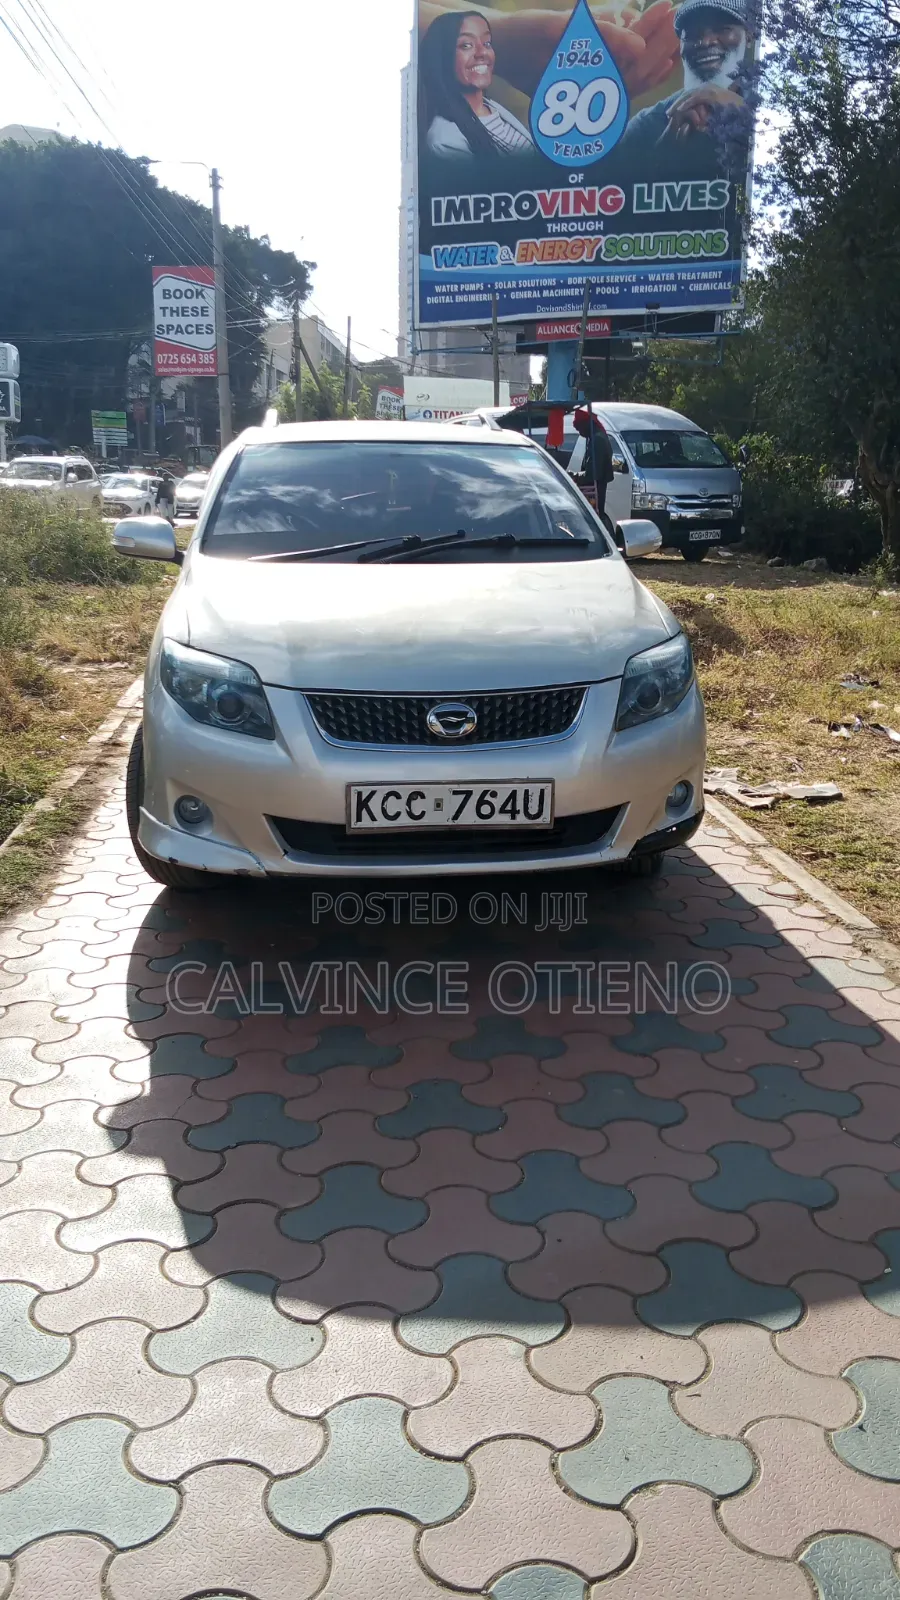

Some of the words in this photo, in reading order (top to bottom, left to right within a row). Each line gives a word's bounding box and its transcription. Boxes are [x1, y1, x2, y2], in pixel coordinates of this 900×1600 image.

[570, 38, 590, 50] EST
[556, 50, 604, 69] 1946
[537, 76, 621, 138] 80
[553, 140, 604, 158] YEARS
[568, 173, 584, 184] OF
[431, 184, 626, 226] IMPROVING
[633, 179, 731, 214] LIVES
[547, 221, 604, 233] THROUGH
[432, 242, 500, 271] WATER
[501, 246, 514, 262] &
[515, 236, 602, 265] ENERGY
[602, 229, 729, 261] SOLUTIONS
[435, 284, 458, 293] WATER
[460, 283, 484, 291] PUMPS
[494, 281, 517, 290] SOLAR
[518, 278, 557, 288] SOLUTIONS
[606, 274, 637, 283] SERVICE
[648, 272, 675, 281] WATER
[677, 271, 723, 280] TREATMENT
[162, 288, 206, 300] BOOK
[427, 296, 454, 304] DIGITAL
[510, 290, 541, 299] GENERAL
[542, 287, 585, 297] MACHINERY
[596, 286, 620, 295] POOLS
[632, 284, 677, 294] IRRIGATION
[689, 282, 732, 291] CHEMICALS
[159, 306, 209, 318] THESE
[156, 323, 214, 336] SPACES
[537, 322, 575, 335] ALLIANCE
[157, 353, 179, 364] 0725
[180, 353, 197, 364] 654
[198, 353, 215, 364] 385
[381, 395, 401, 404] BOOK
[355, 789, 426, 822] KCC
[451, 788, 545, 821] 764U
